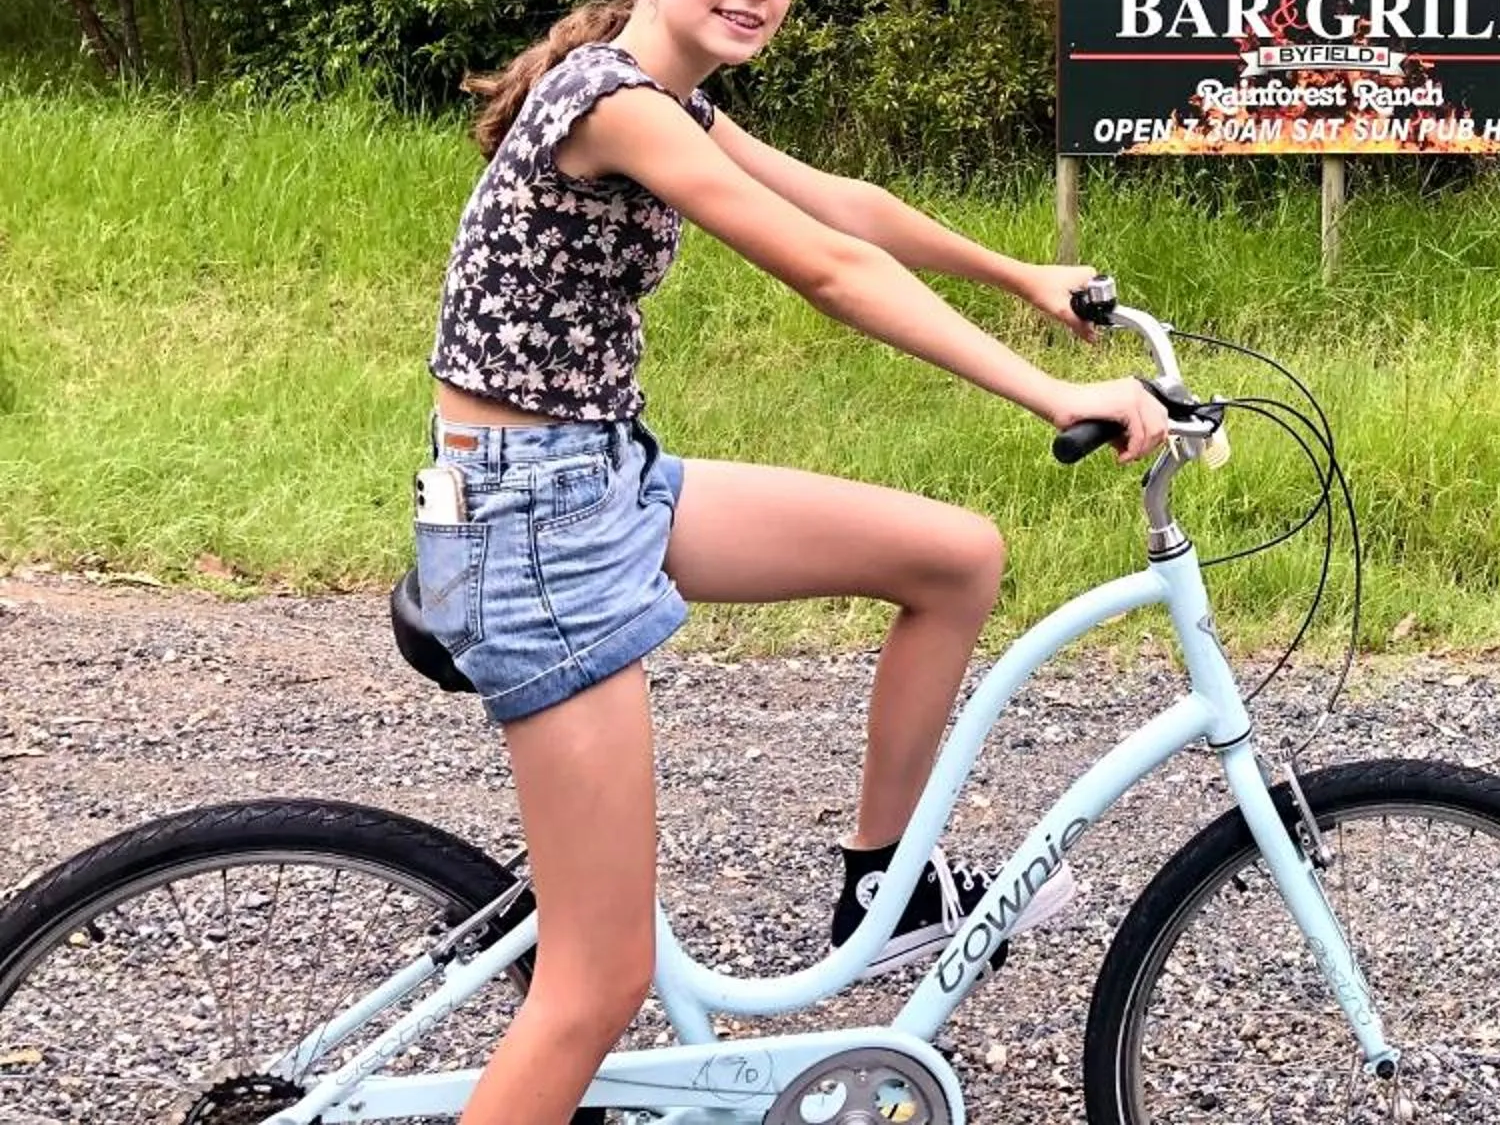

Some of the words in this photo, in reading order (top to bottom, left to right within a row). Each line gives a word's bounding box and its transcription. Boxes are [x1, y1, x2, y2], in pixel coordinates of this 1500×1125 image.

[1279, 46, 1374, 64] BYFIELD
[1196, 79, 1347, 114] Rainforest
[1352, 79, 1444, 115] Ranch
[1094, 118, 1174, 142] OPEN
[1291, 118, 1344, 141] SAT
[1353, 118, 1411, 141] SUN
[1418, 118, 1474, 142] PUB
[937, 816, 1090, 994] townie
